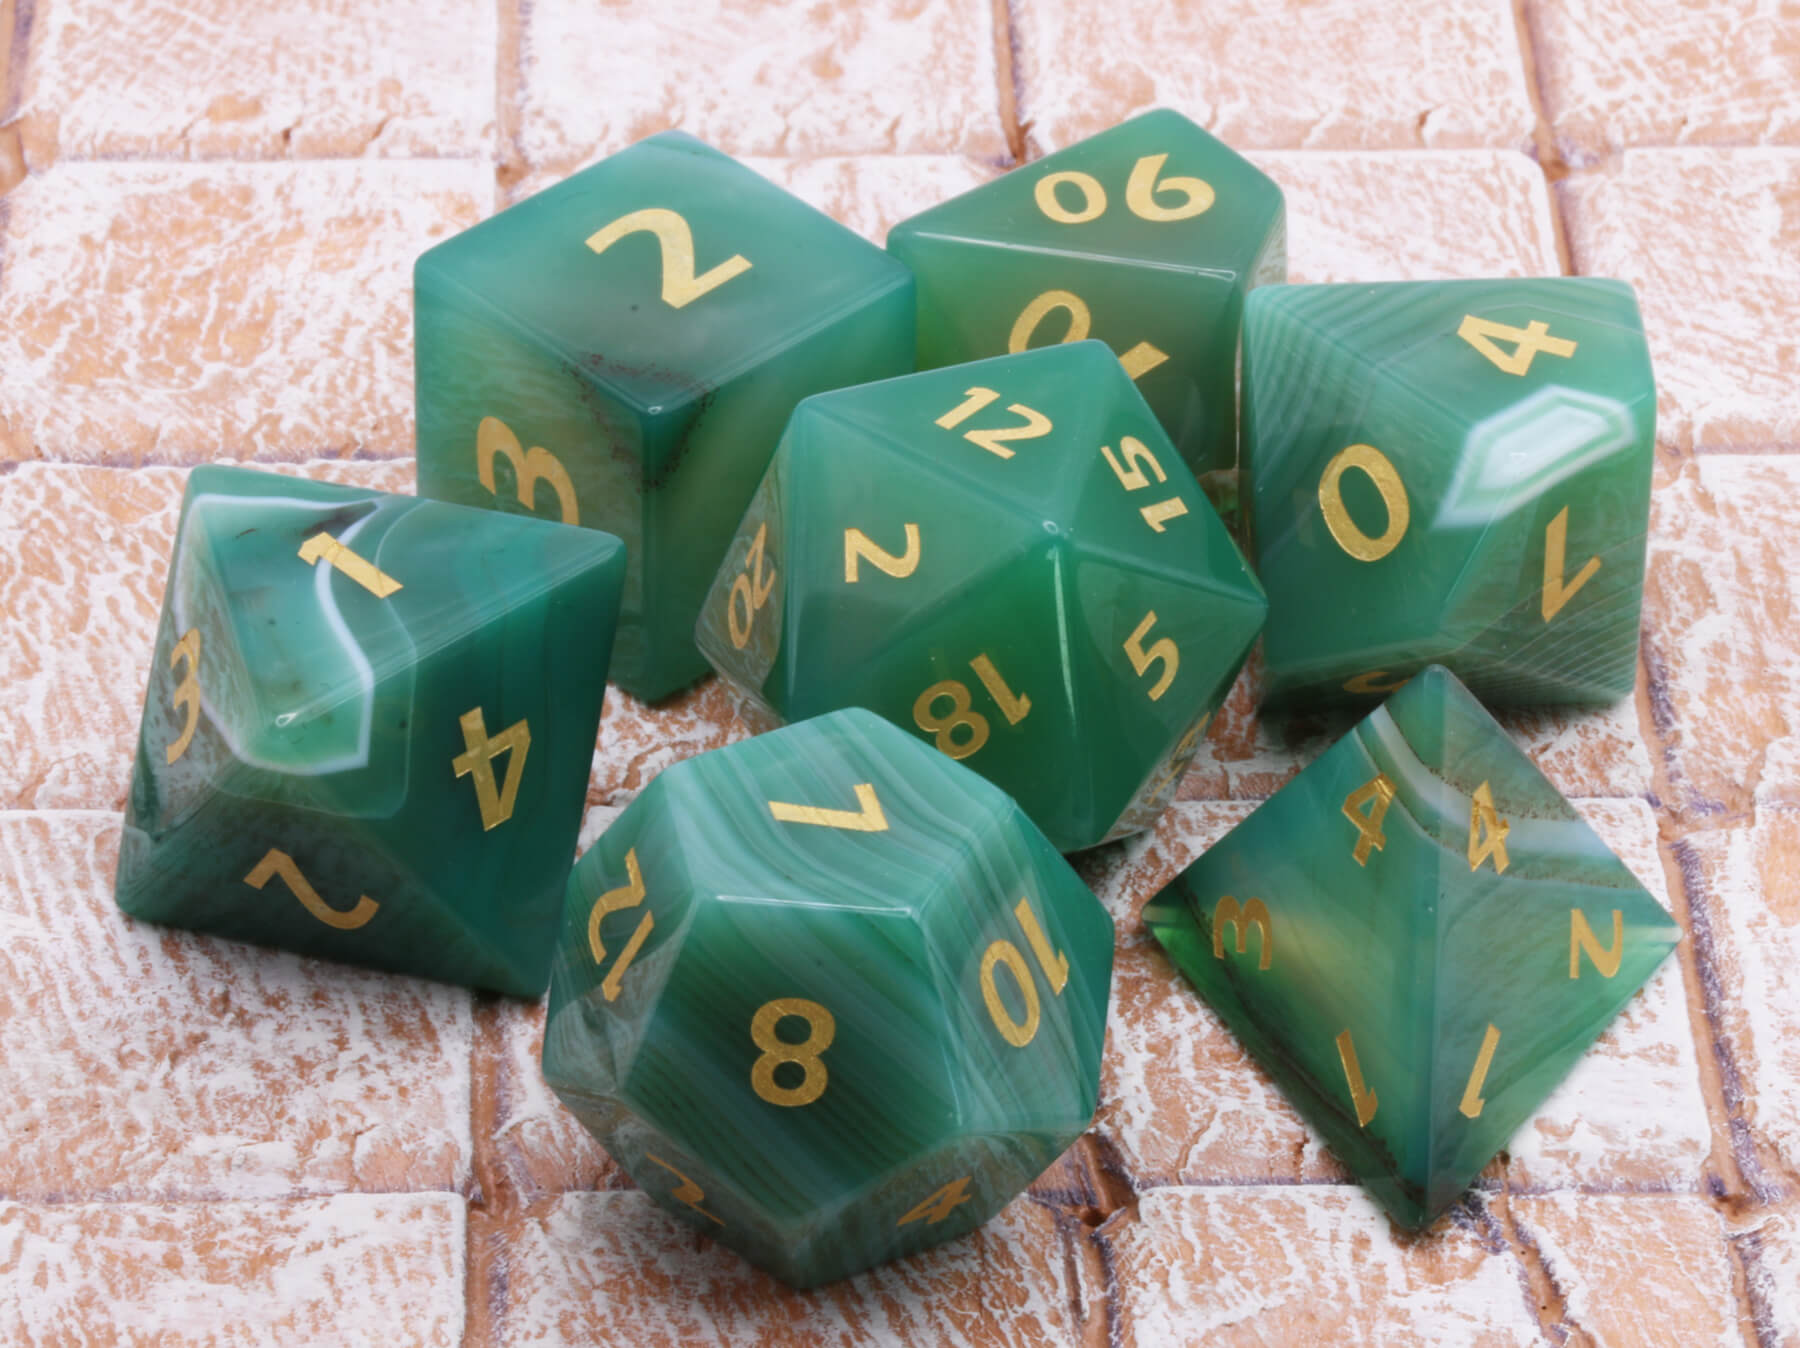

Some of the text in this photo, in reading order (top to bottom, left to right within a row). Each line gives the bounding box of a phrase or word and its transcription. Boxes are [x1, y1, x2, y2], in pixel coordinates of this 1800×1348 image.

[585, 208, 753, 309] 2
[1457, 314, 1578, 377] 4
[476, 416, 580, 526] 3
[934, 386, 1055, 460] 12
[1100, 436, 1189, 534] 15
[1318, 443, 1410, 562] 0
[297, 532, 403, 599] 1
[727, 522, 777, 650] 20
[844, 523, 921, 583] 2
[166, 627, 199, 765] 3
[1122, 611, 1180, 702] 5
[912, 652, 1033, 760] 18
[452, 706, 532, 832] 4
[767, 783, 890, 832] 7
[1341, 773, 1397, 867] 4
[1468, 779, 1511, 875] 4
[244, 847, 380, 930] 2
[588, 848, 655, 1003] 12
[1213, 895, 1273, 971] 3
[979, 896, 1070, 1048] 10
[1569, 908, 1624, 979] 2
[749, 997, 837, 1107] 8
[1335, 1028, 1379, 1128] 1
[1458, 1022, 1501, 1119] 1
[896, 1176, 973, 1227] 4
